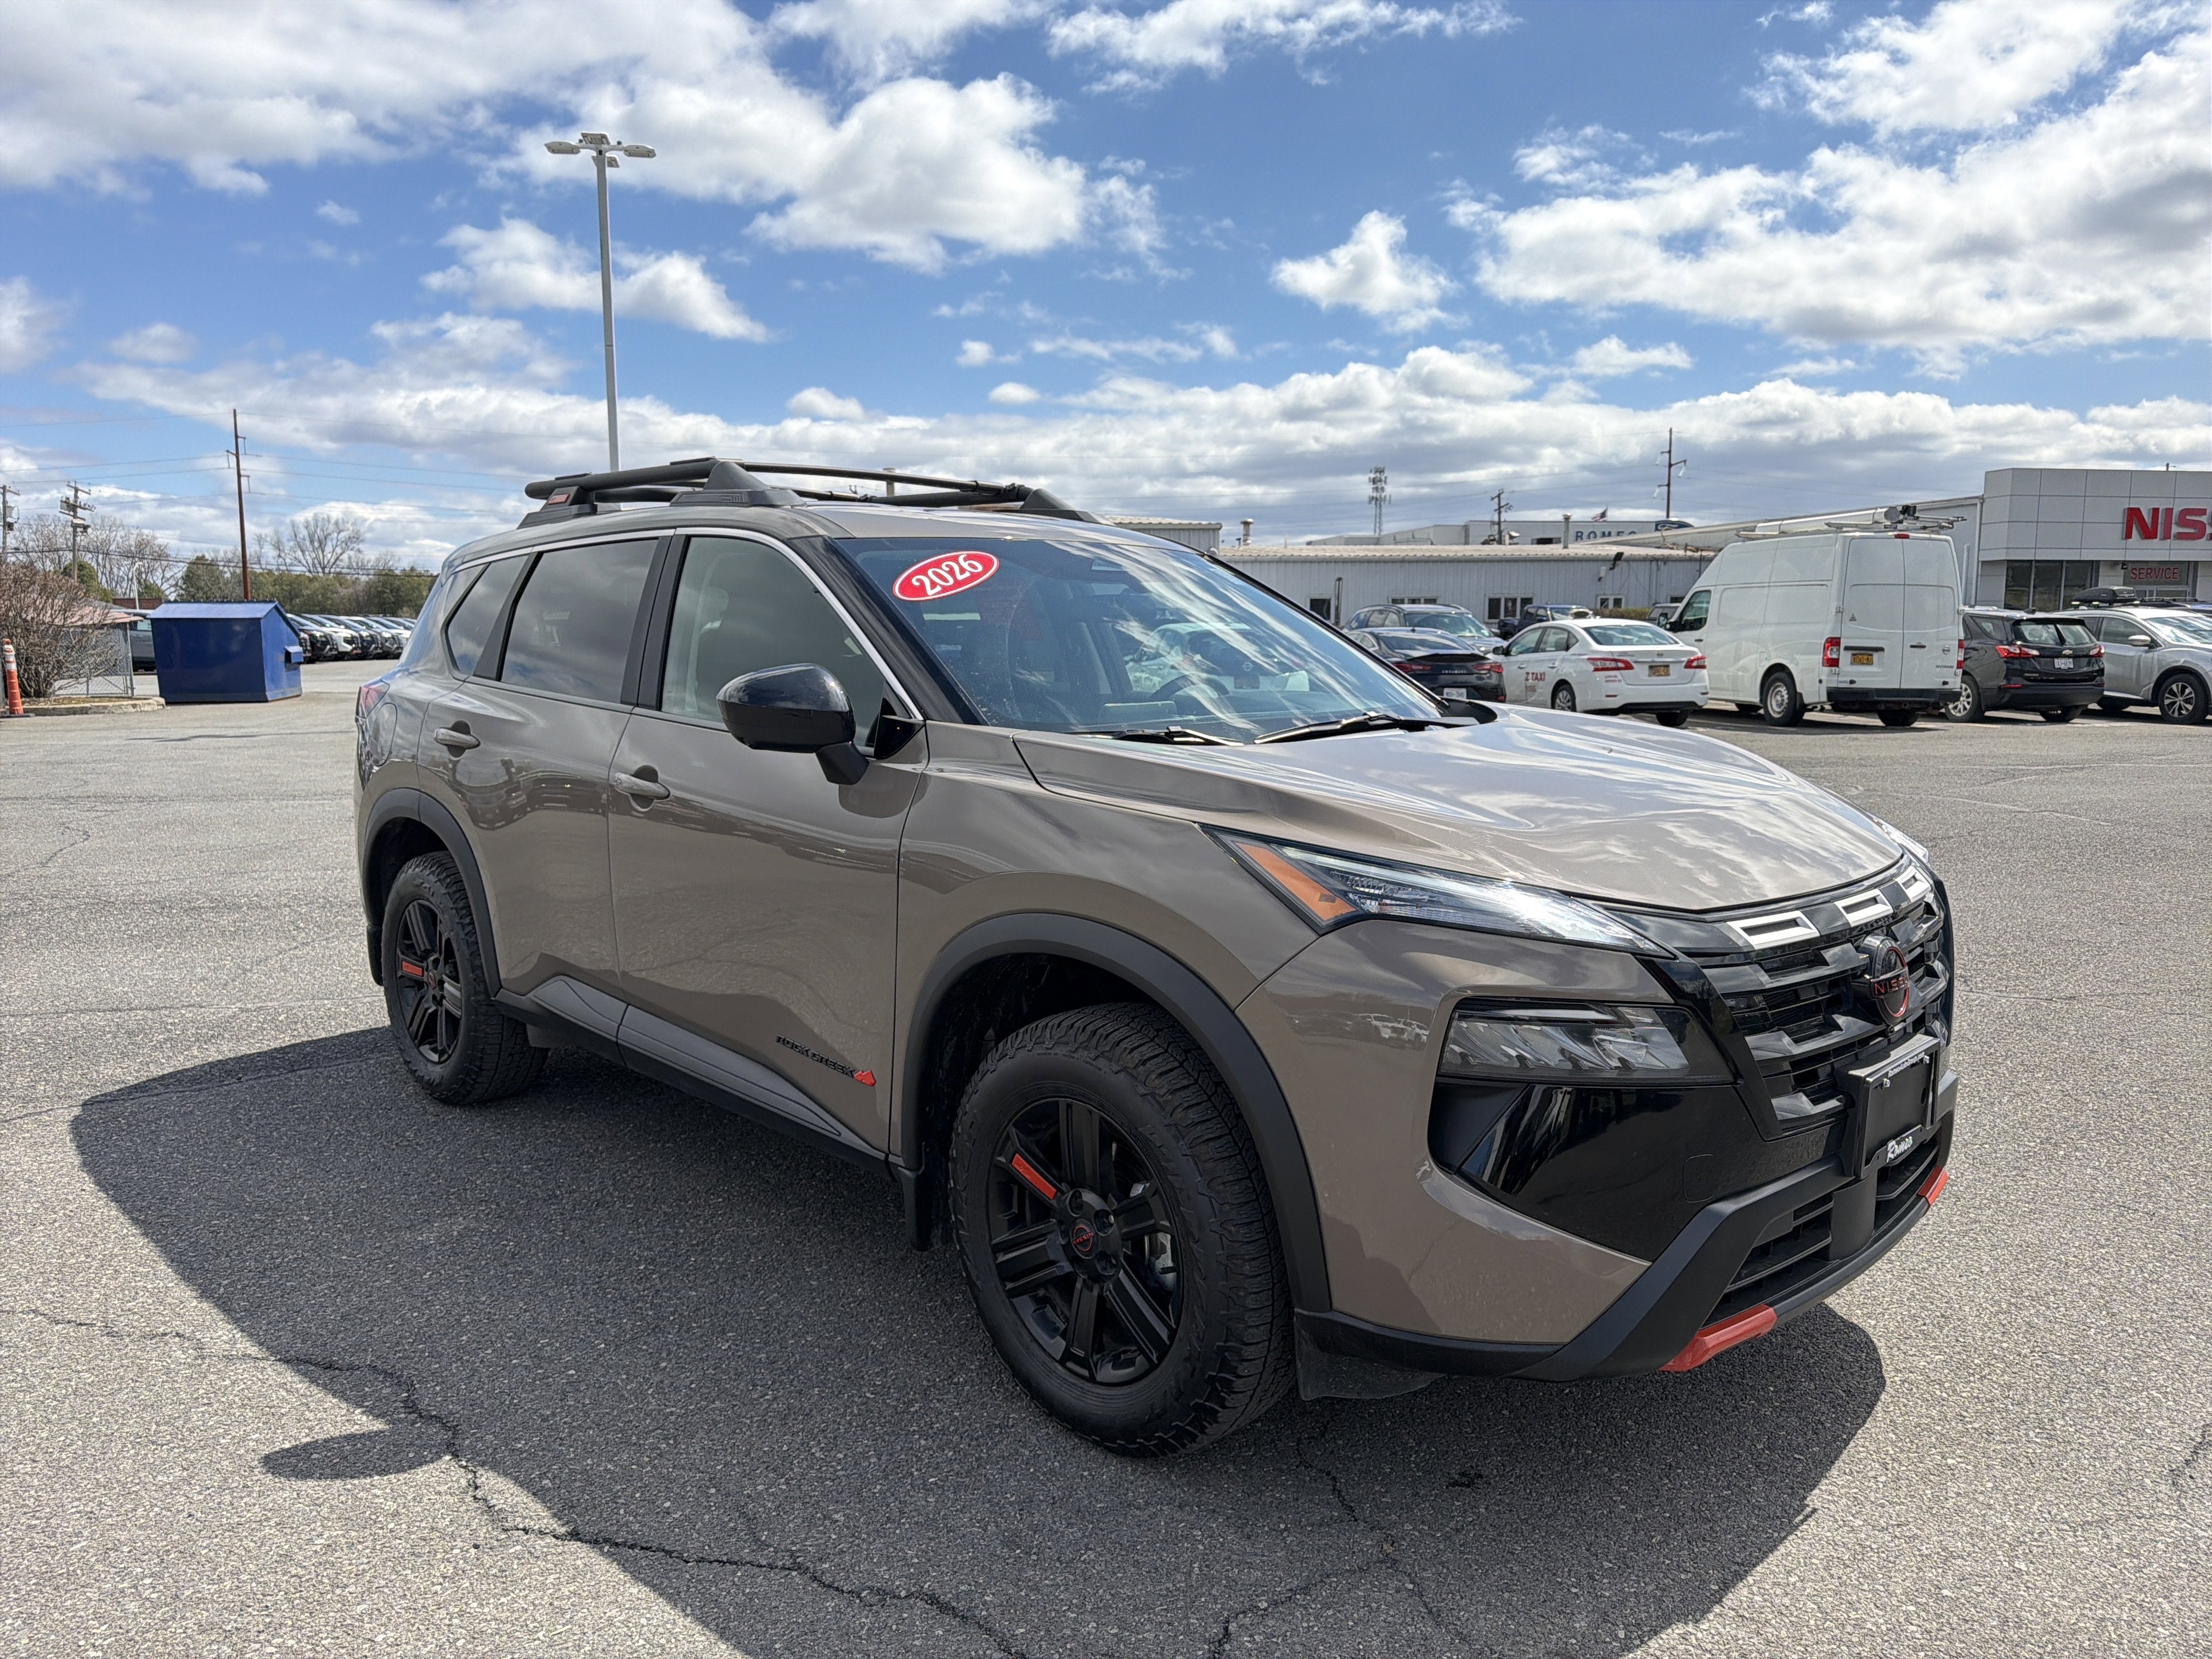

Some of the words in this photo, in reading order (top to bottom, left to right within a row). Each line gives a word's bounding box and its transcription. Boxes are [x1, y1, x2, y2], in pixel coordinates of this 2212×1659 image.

[2124, 507, 2212, 540] NIS
[911, 554, 983, 596] 2026
[2130, 567, 2179, 580] SERVICE
[1525, 672, 1530, 682] Z
[1531, 672, 1546, 682] TAXI
[776, 1034, 810, 1058] ROCK
[810, 1049, 856, 1078] CREEK
